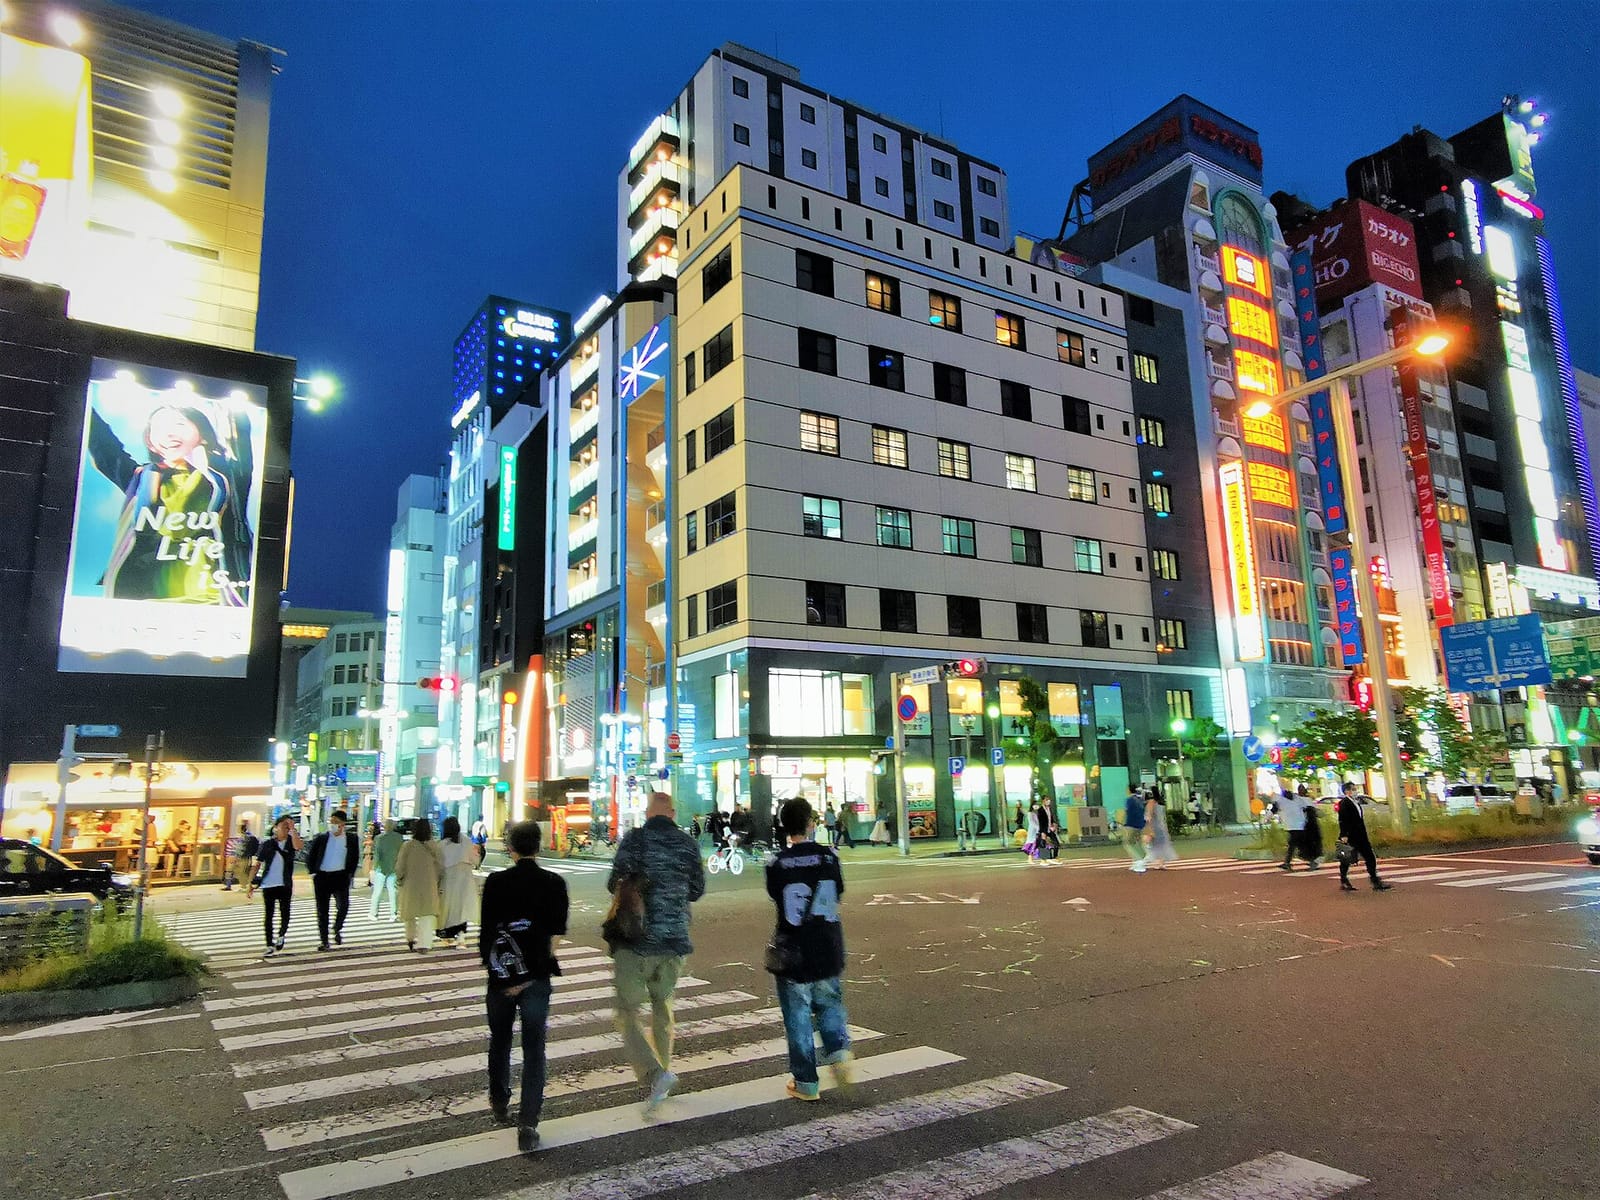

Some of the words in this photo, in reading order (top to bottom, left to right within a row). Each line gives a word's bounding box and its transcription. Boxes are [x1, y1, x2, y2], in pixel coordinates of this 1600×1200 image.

[1368, 218, 1409, 246] カラオケ
[1417, 474, 1435, 529] カラオケ
[135, 506, 218, 532] New
[156, 536, 225, 566] Life
[952, 759, 962, 773] P
[993, 750, 1002, 764] P
